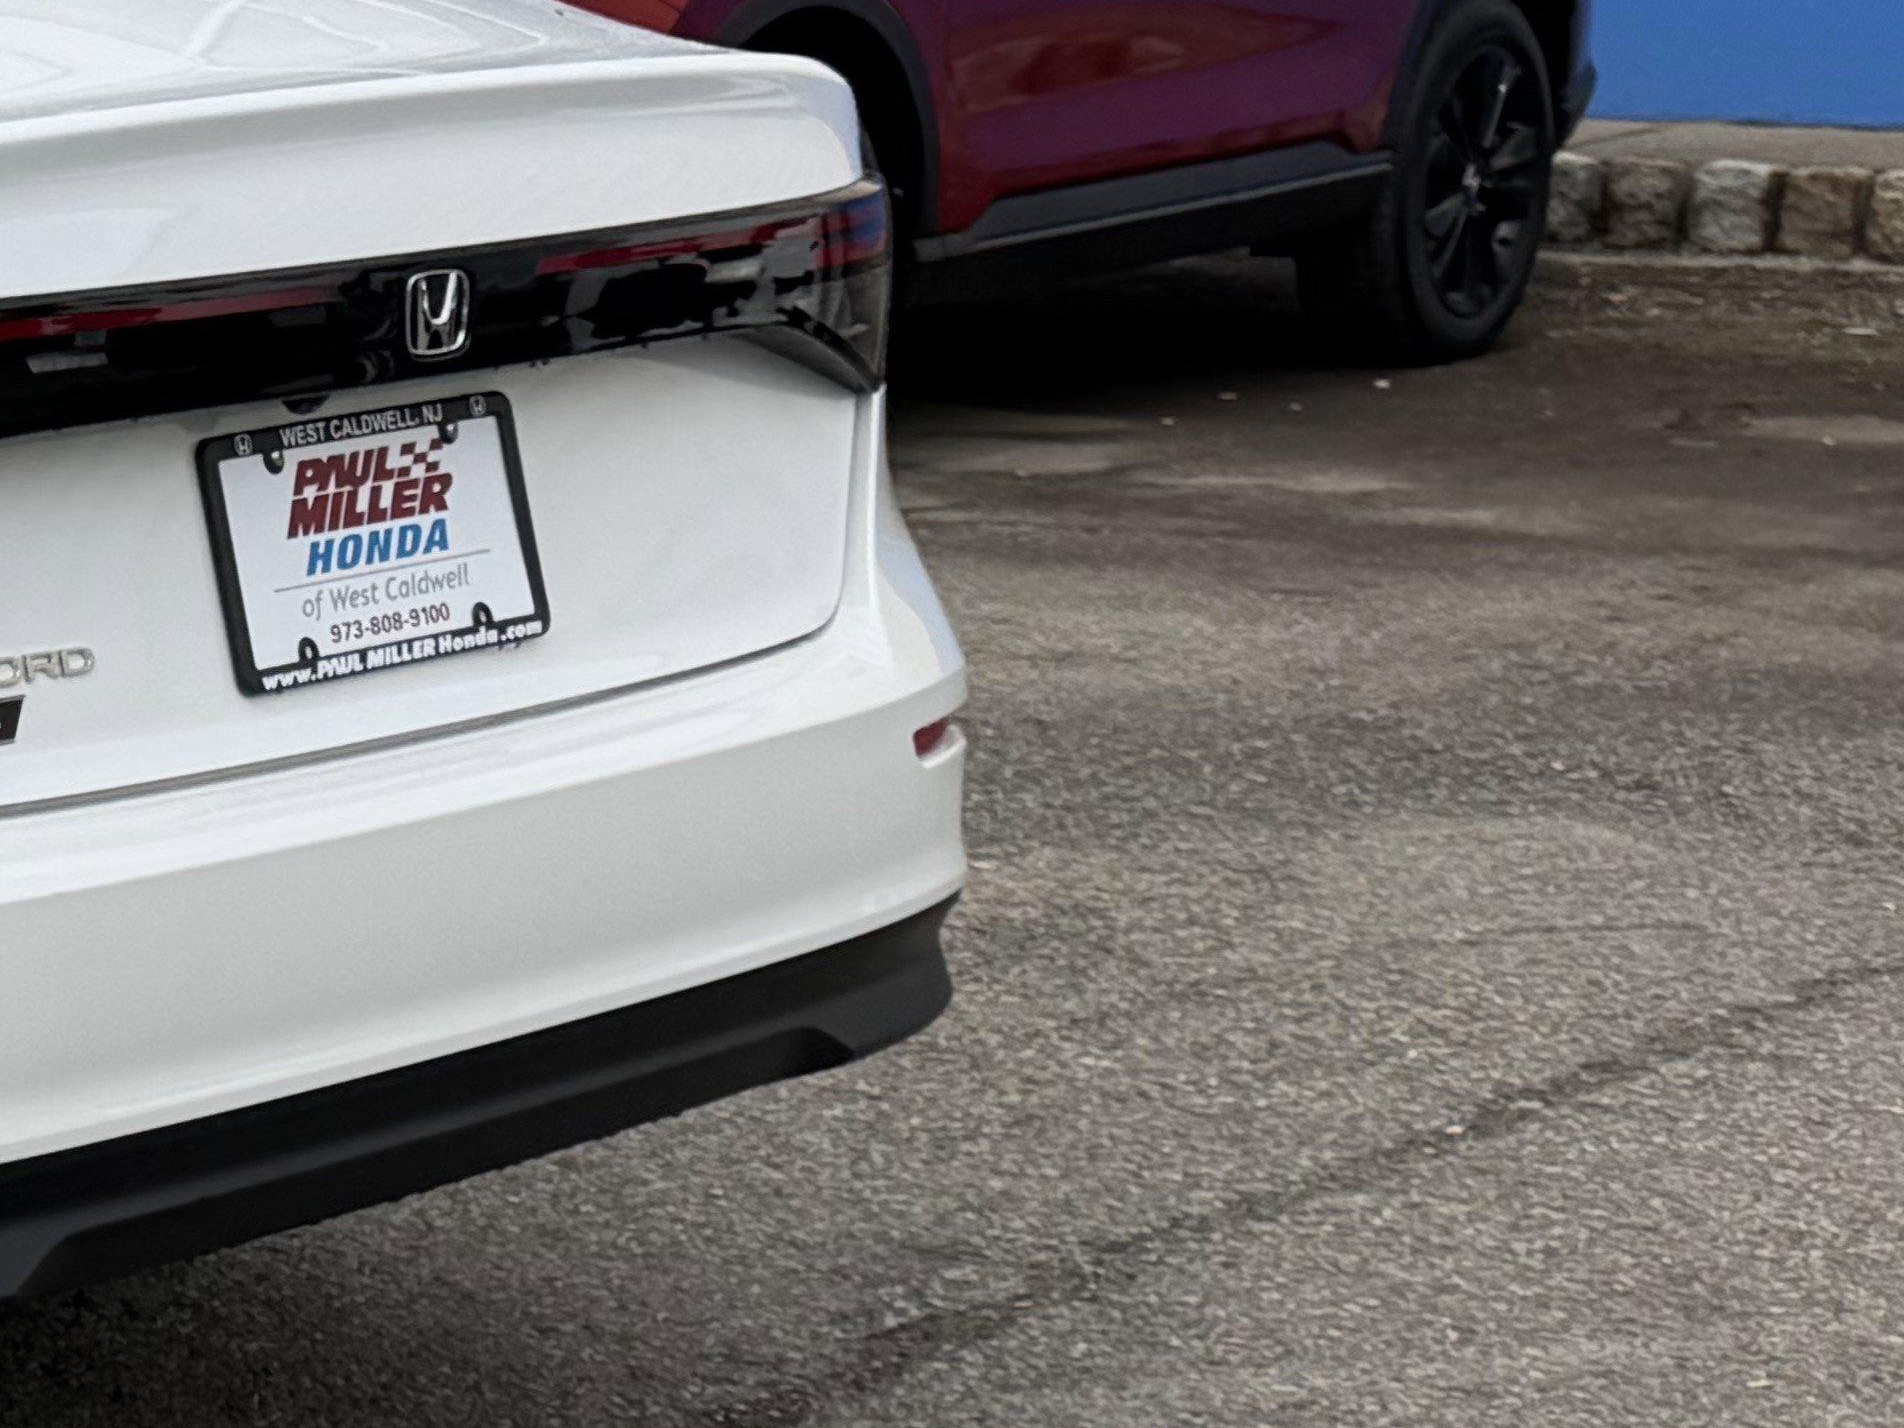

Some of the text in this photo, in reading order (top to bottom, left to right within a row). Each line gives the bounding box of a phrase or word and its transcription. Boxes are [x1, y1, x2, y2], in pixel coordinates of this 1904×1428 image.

[279, 420, 326, 448] WEST
[422, 403, 443, 423] NJ
[293, 445, 400, 497] PAUL
[287, 471, 454, 540] MILLER
[306, 518, 450, 576] HONDA
[302, 562, 471, 619] of West Caldwell
[330, 602, 451, 644] 973-808-9100
[366, 639, 436, 670] MILLER
